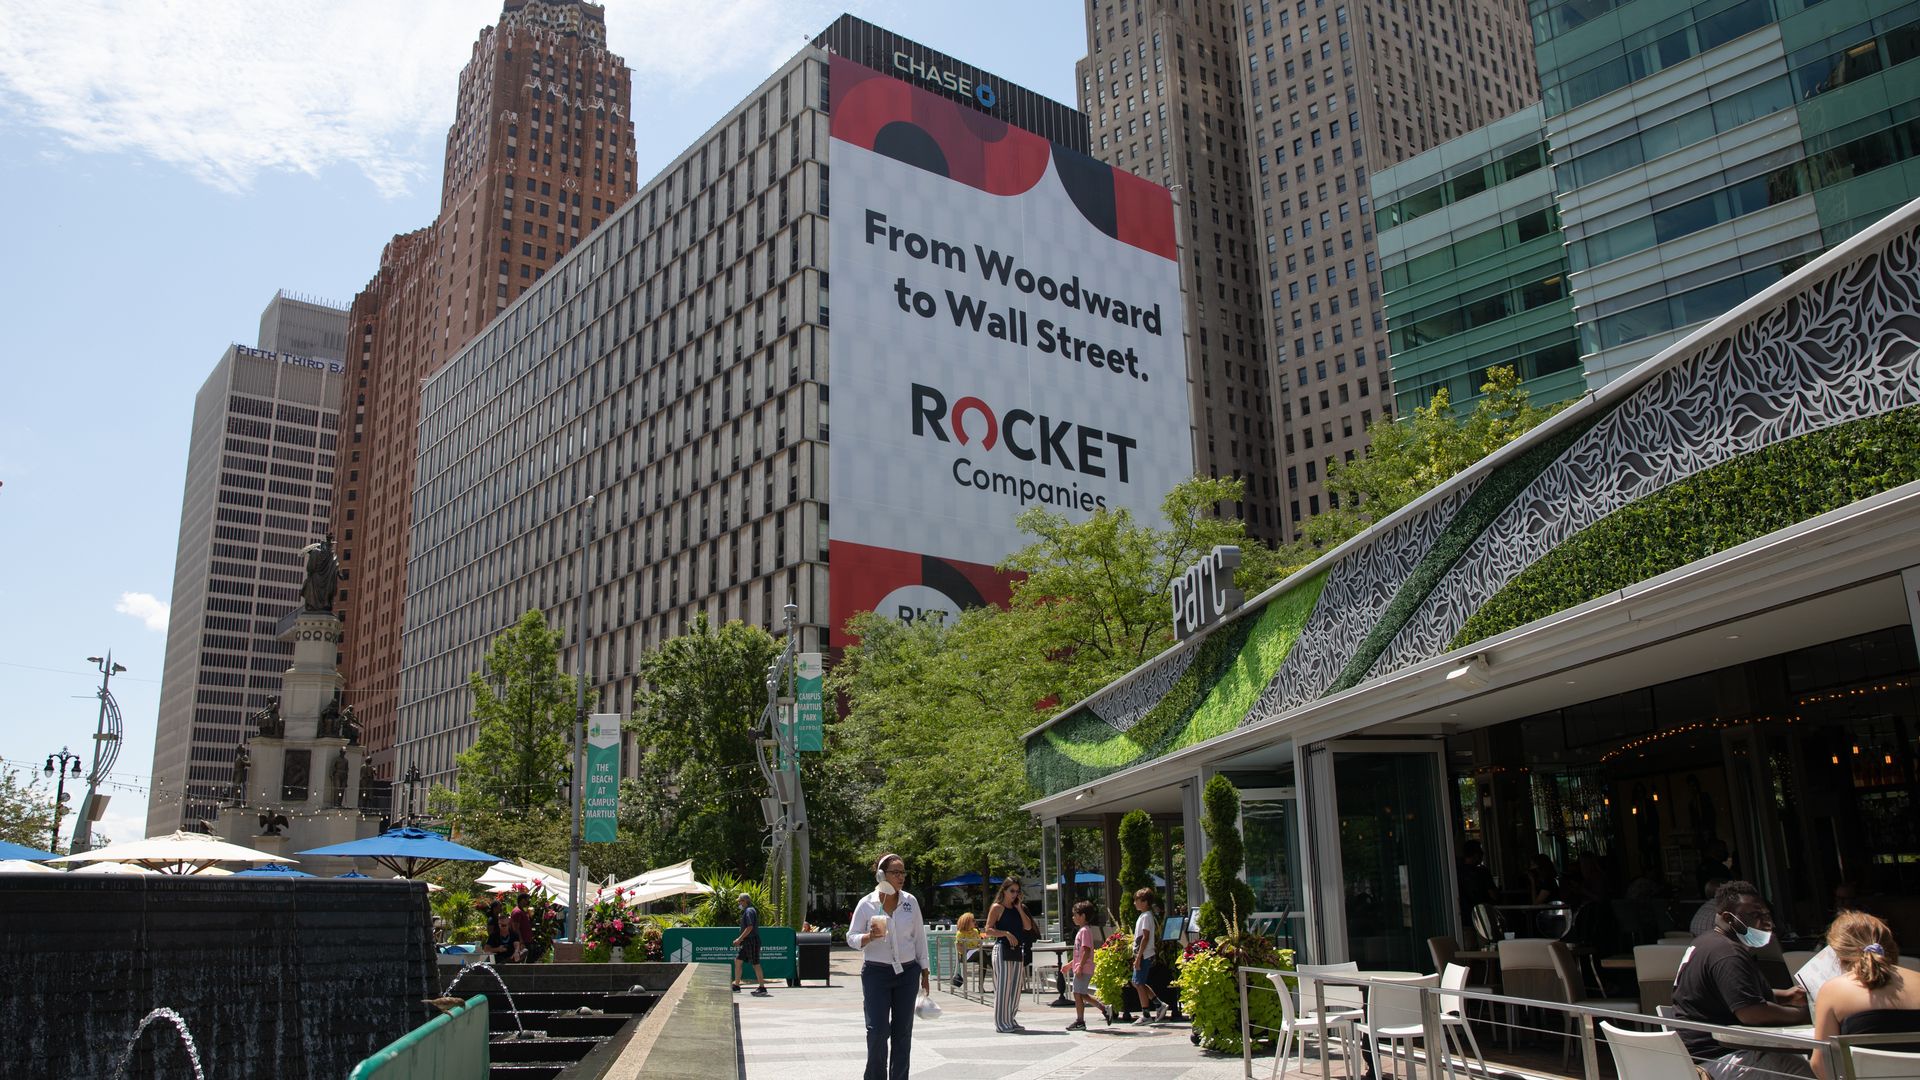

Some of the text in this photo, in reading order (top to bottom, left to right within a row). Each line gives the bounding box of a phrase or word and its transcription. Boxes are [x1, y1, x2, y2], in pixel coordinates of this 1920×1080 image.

[893, 51, 973, 98] CHASE
[865, 208, 1162, 336] From Woodward
[894, 277, 1149, 382] to Wall Street.
[236, 344, 345, 375] FIFTH THIRD BA
[911, 382, 1137, 484] ROCKET
[952, 457, 1107, 512] Companies
[798, 692, 821, 701] CAMPUS
[798, 702, 822, 711] MARTIUS
[802, 713, 817, 721] PARK
[595, 763, 609, 772] THE
[591, 775, 613, 783] BEACH
[597, 786, 606, 795] AT
[587, 798, 615, 807] CAMPUS
[585, 809, 616, 818] MARTIUS
